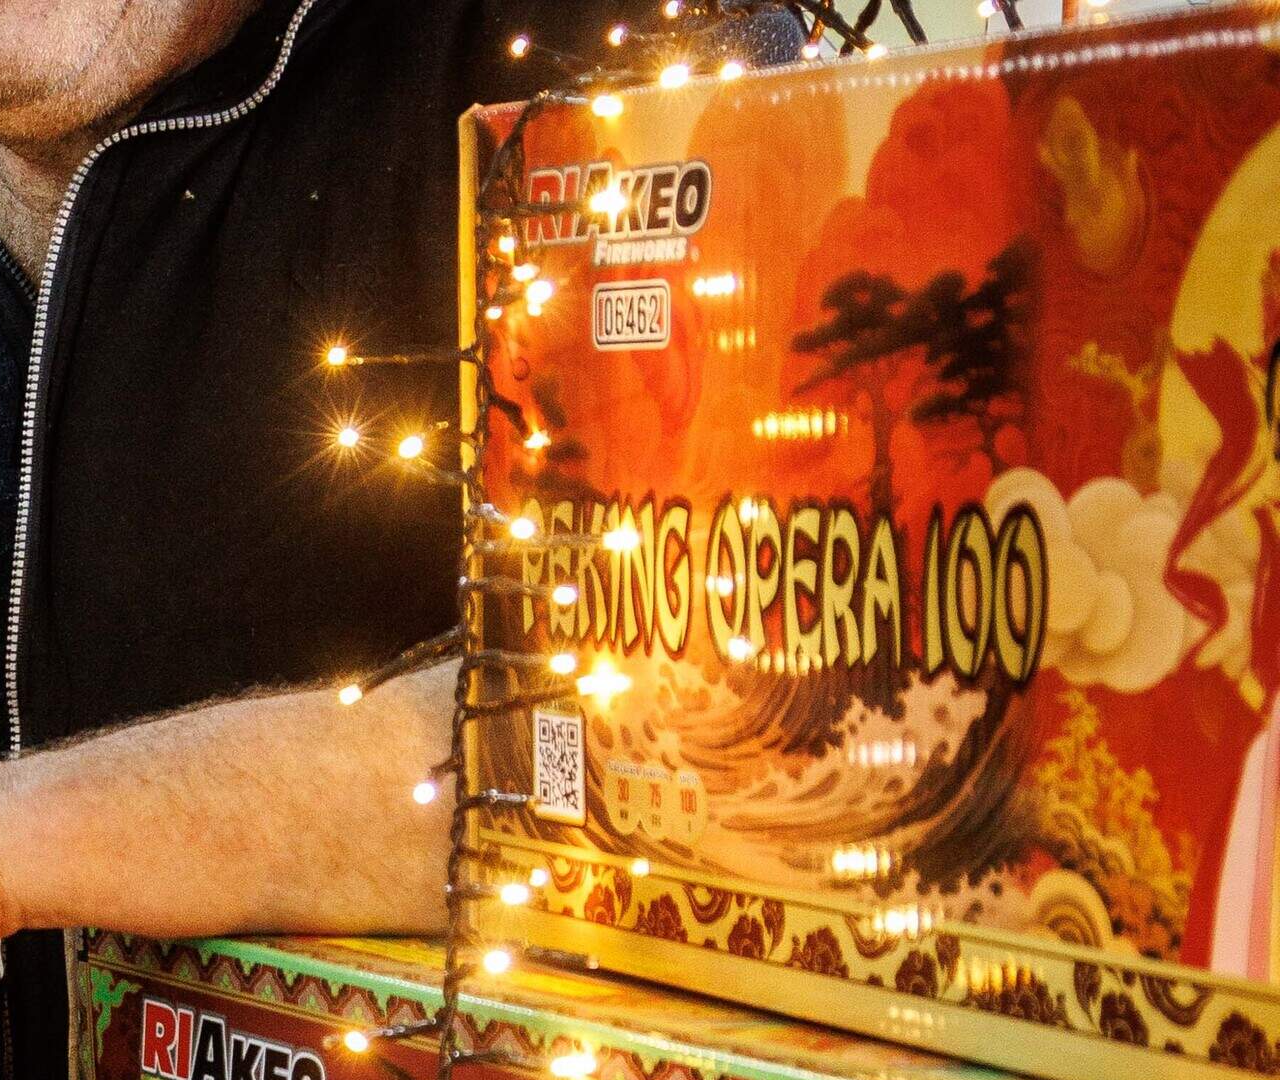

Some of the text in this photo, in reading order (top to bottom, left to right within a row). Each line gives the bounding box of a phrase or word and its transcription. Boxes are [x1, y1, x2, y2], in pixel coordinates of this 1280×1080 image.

[604, 292, 661, 337] 06462
[522, 498, 1048, 682] PEKING OPERA 100
